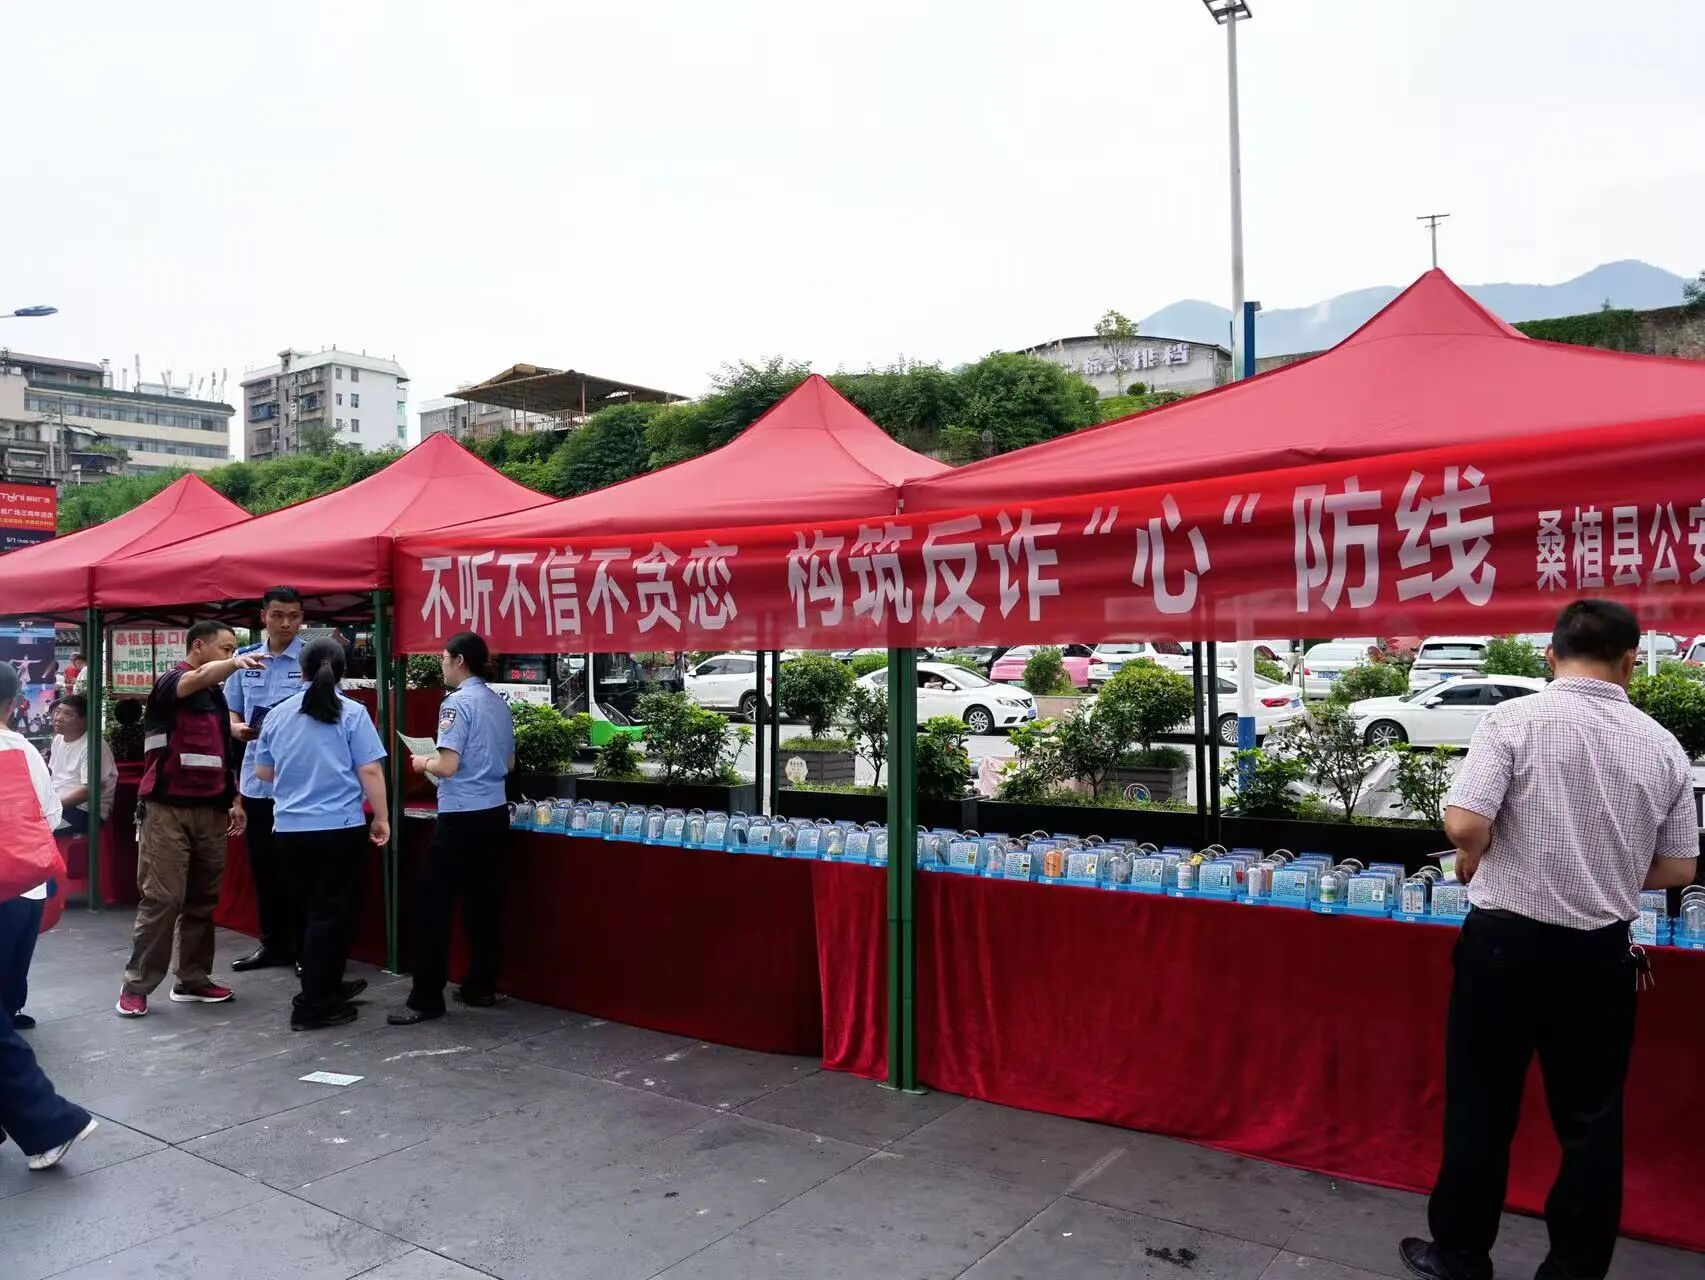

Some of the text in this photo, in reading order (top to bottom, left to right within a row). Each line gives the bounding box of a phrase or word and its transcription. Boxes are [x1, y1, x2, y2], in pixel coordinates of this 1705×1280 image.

[421, 540, 738, 637] 不听不信不贪恋
